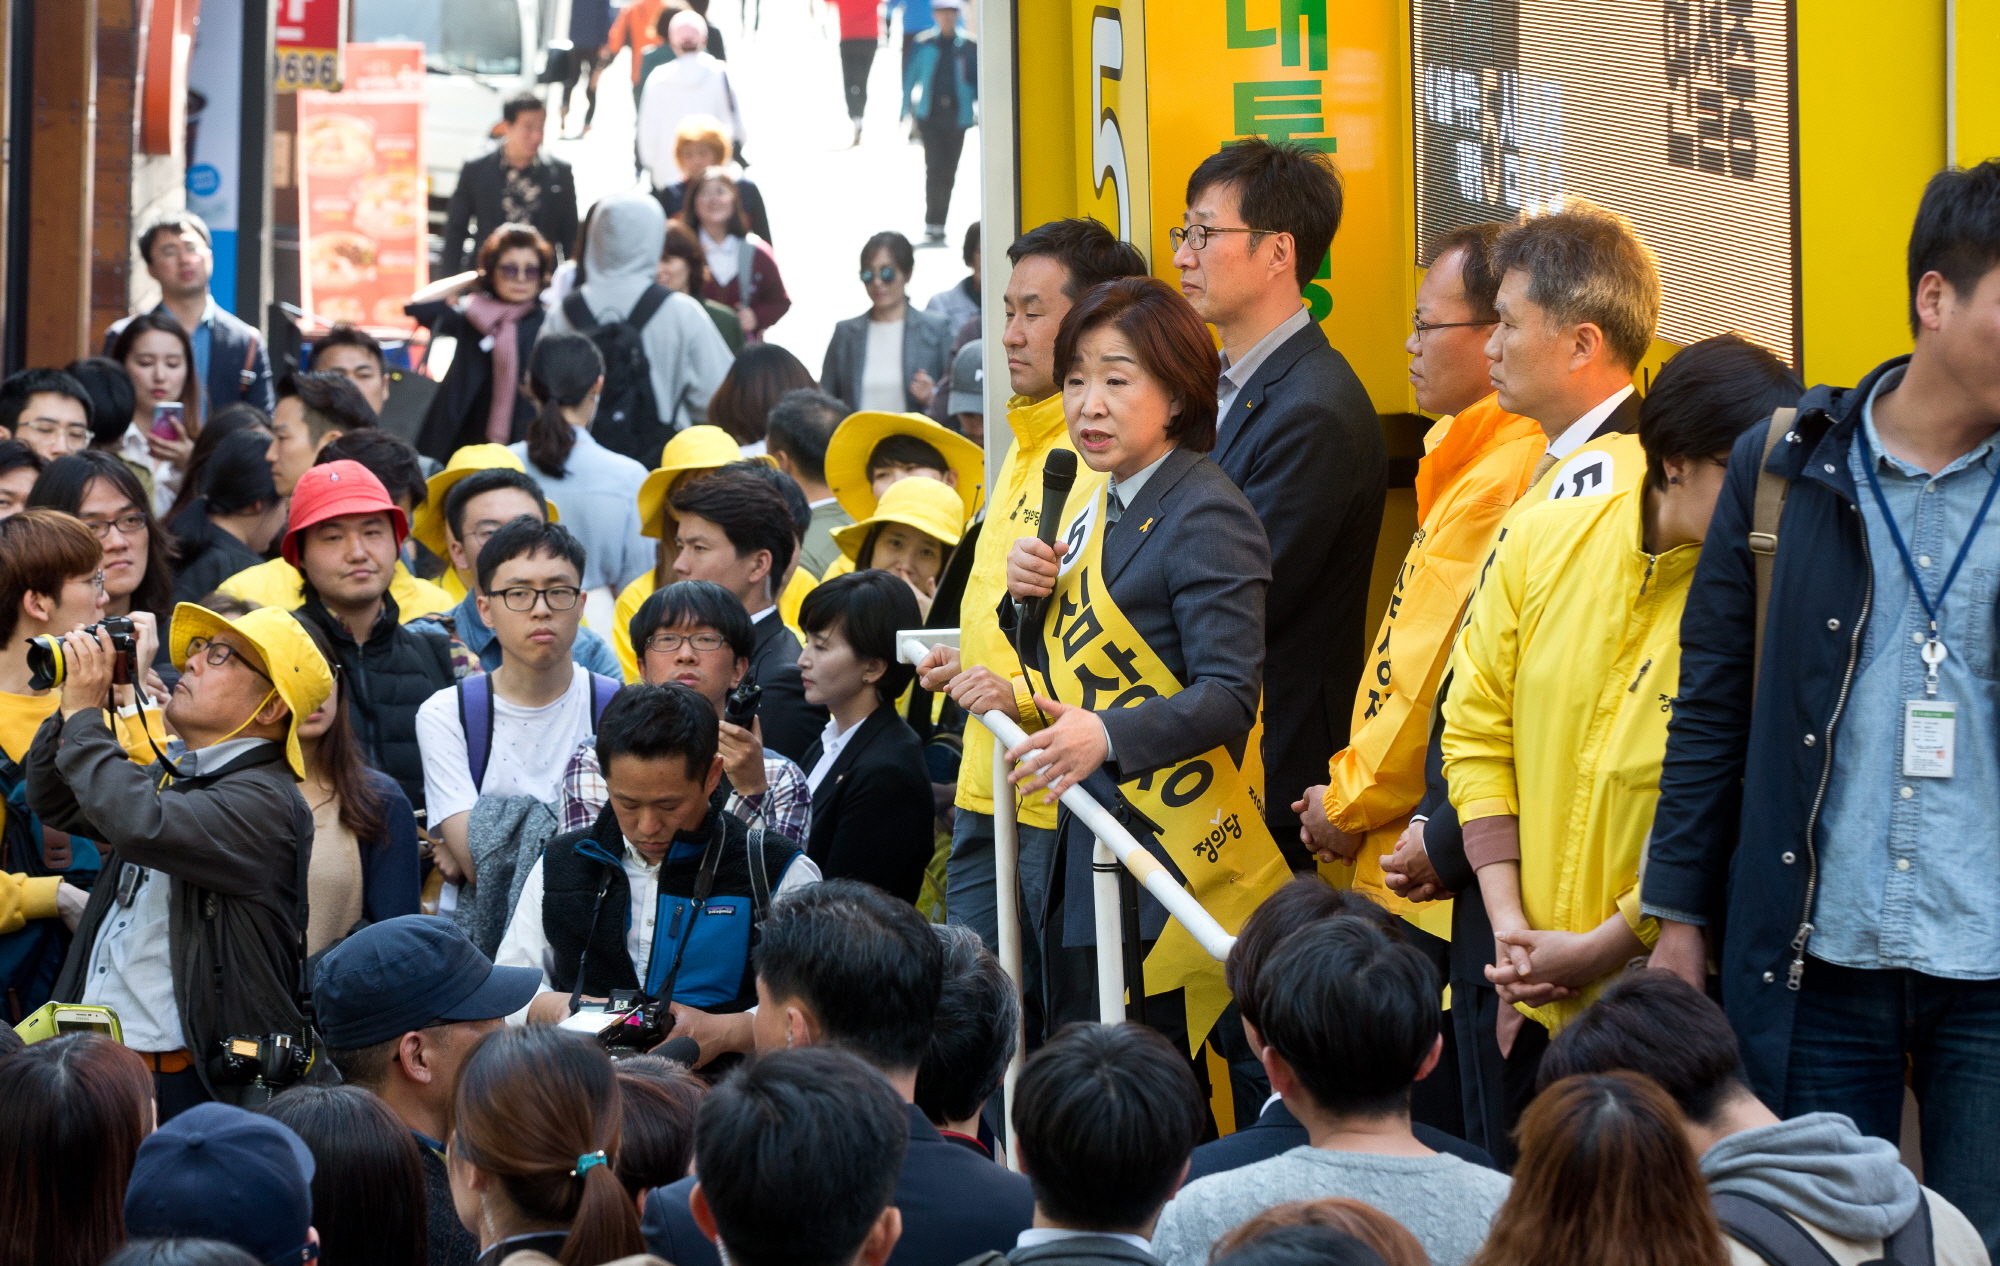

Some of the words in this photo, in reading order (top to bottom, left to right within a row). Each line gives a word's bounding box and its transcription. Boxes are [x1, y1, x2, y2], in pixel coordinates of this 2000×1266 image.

[1091, 4, 1131, 250] 5
[1062, 506, 1086, 565] 5
[1192, 813, 1242, 864] 정의당
